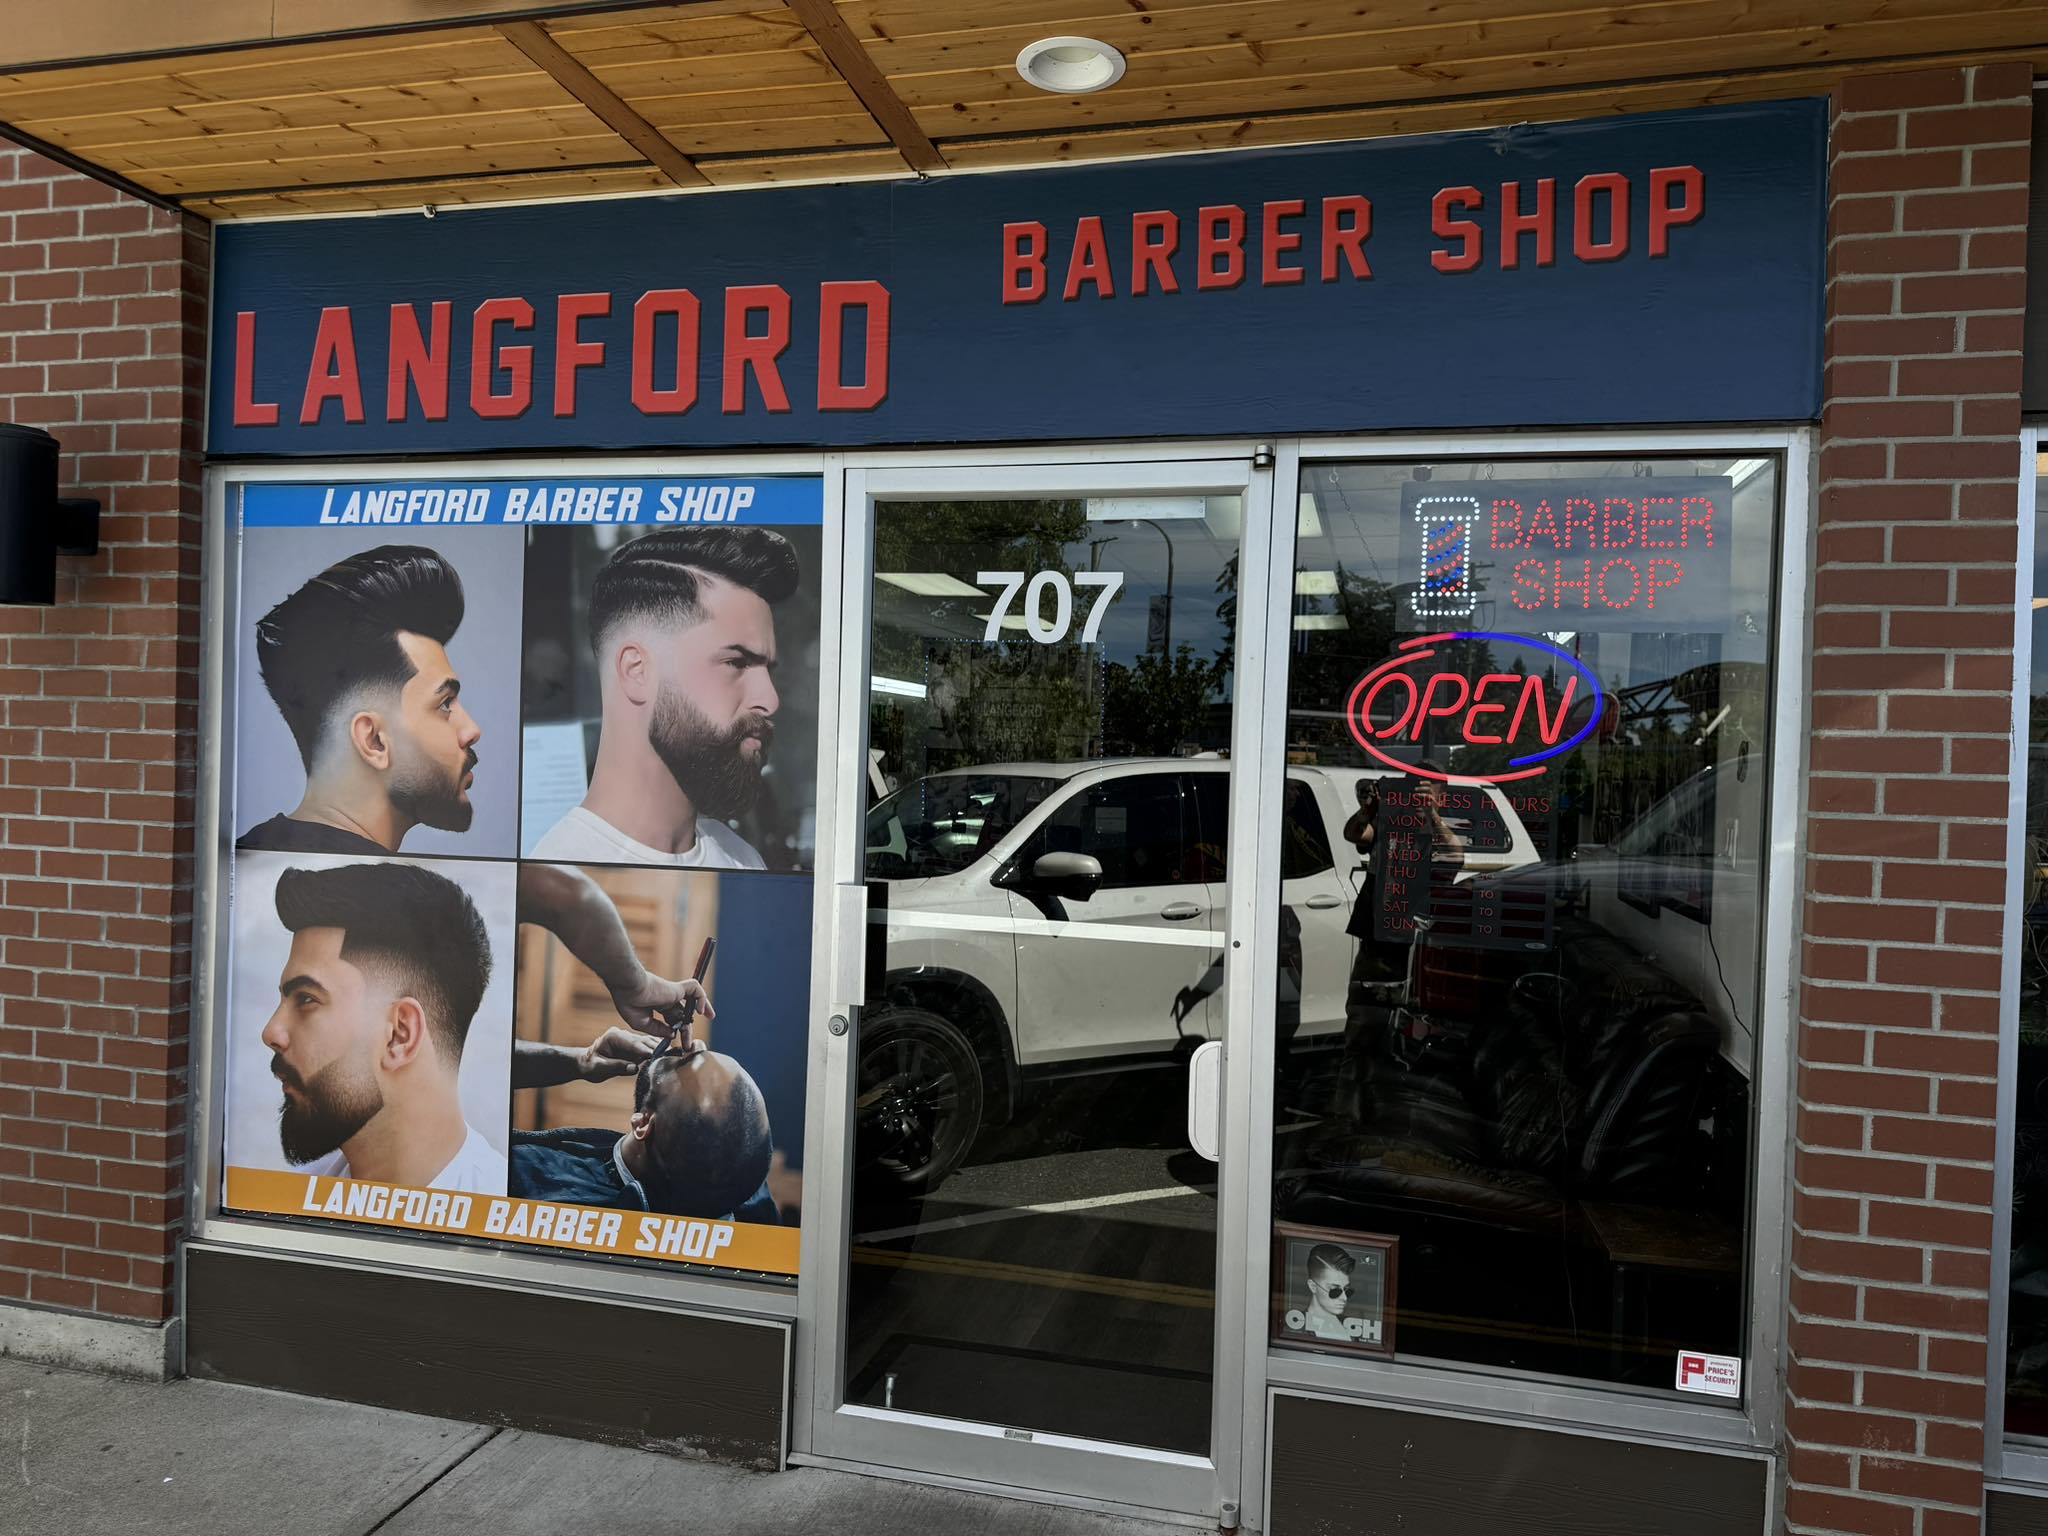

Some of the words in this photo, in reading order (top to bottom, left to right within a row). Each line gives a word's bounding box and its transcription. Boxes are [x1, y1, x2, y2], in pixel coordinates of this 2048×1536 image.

[233, 280, 891, 428] LANGFORD
[1002, 194, 1374, 306] BARBER
[1430, 165, 1706, 275] SHOP
[319, 487, 491, 525] LANGFORD
[502, 486, 644, 523] BARBER
[655, 485, 756, 522] SHOP
[1489, 496, 1715, 550] BARBER
[1510, 557, 1686, 611] SHOP
[976, 570, 1125, 645] 707
[1360, 671, 1579, 745] OPEN
[1386, 791, 1473, 810] BUSINESS
[1480, 796, 1552, 814] HURS
[1387, 815, 1425, 829] MON
[1480, 820, 1497, 830] TO
[1387, 832, 1416, 845] TUE
[1385, 866, 1417, 879] THU
[1384, 883, 1407, 896] FRI
[1384, 901, 1409, 912] SAT
[302, 1175, 472, 1230] LANGFORD
[483, 1200, 621, 1249] BARBER
[634, 1217, 735, 1260] SHOP
[1704, 1374, 1737, 1386] SECURITY
[1707, 1366, 1735, 1377] PRICE'S
